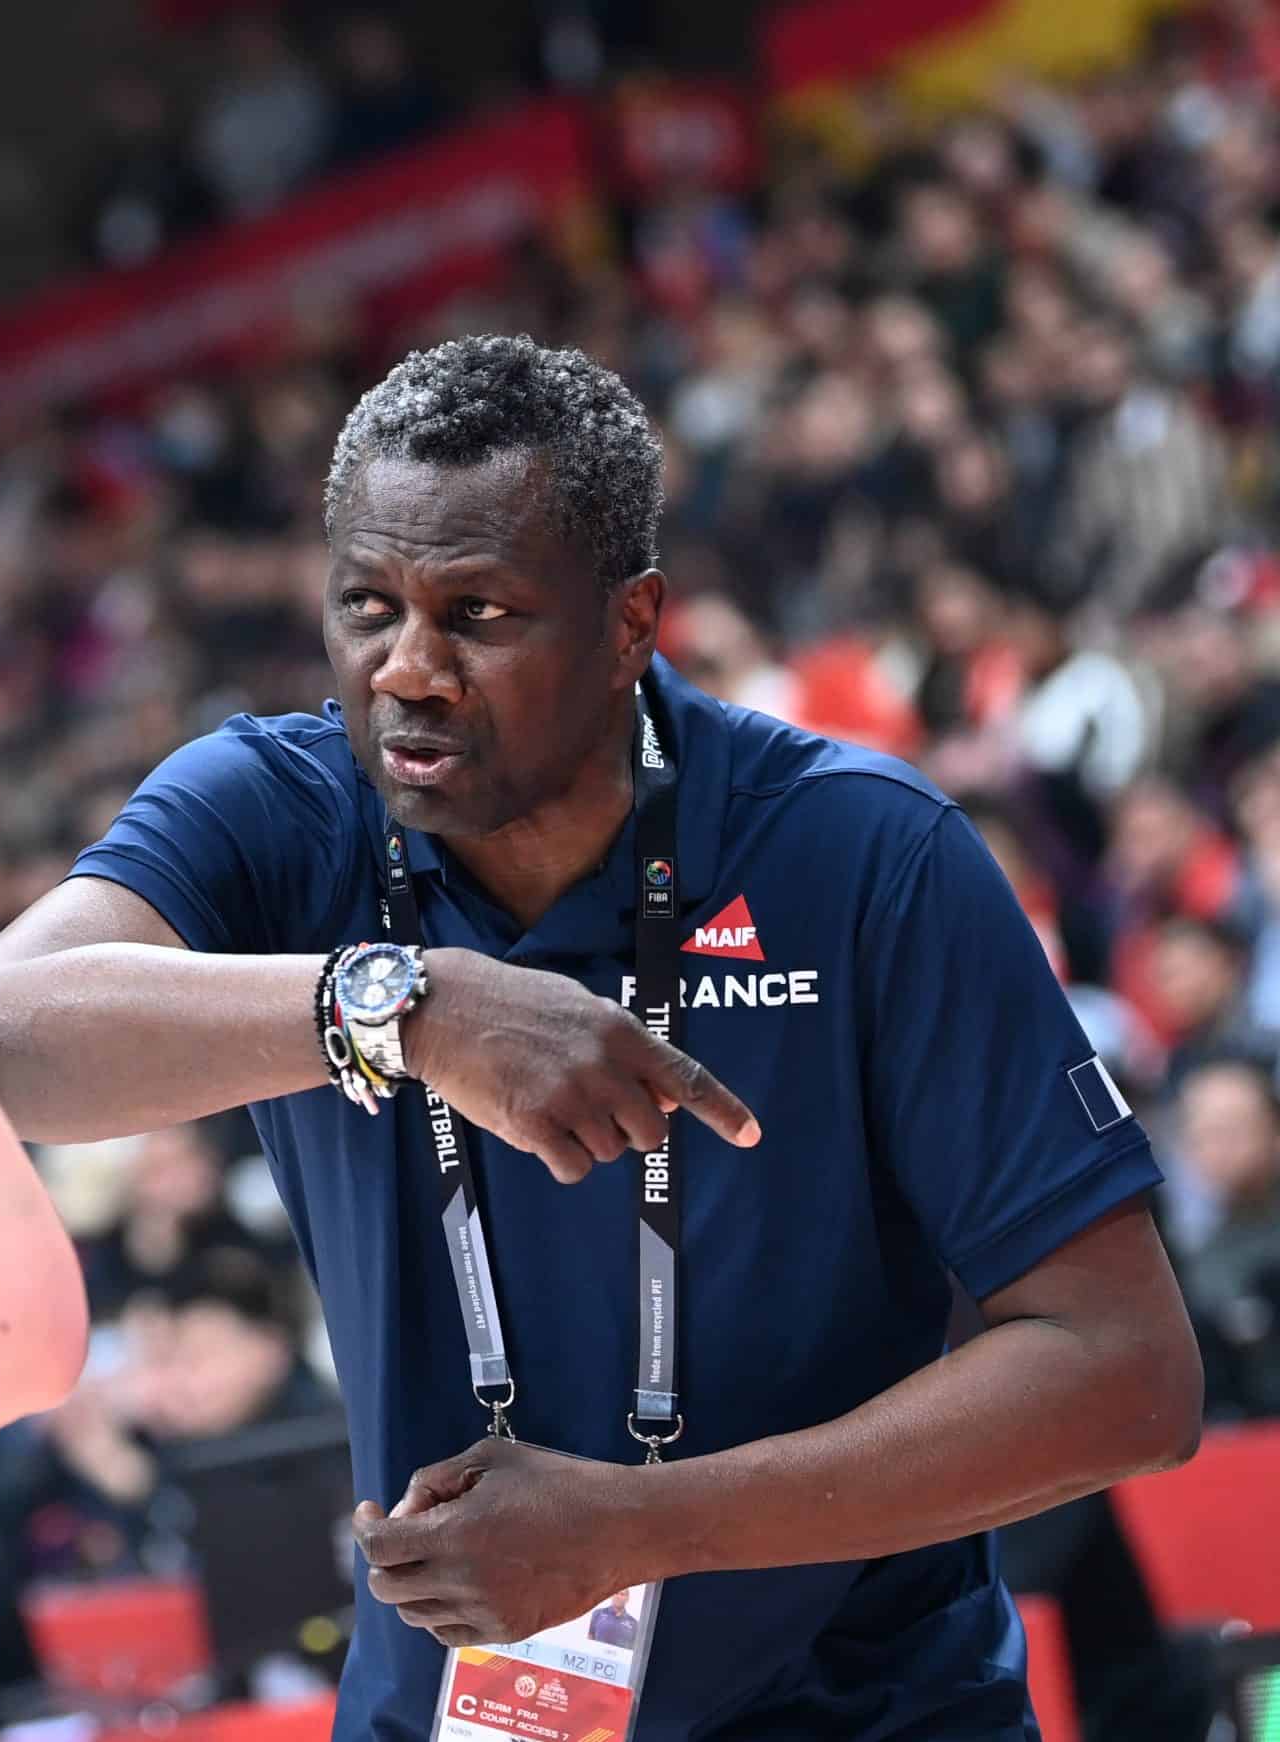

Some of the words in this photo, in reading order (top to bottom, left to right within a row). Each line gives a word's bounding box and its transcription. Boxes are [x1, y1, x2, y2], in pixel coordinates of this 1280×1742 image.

[648, 892, 669, 903] FIBA
[695, 926, 756, 948] MAIF
[621, 970, 819, 1008] FANCE
[425, 1087, 460, 1174] ETBALL
[651, 1279, 662, 1294] PET
[651, 1296, 664, 1333] recycled
[651, 1335, 662, 1357] from
[650, 1359, 661, 1383] Made
[563, 1653, 586, 1670] MZ
[594, 1662, 616, 1677] PC
[456, 1694, 477, 1716] C
[482, 1699, 512, 1714] TEAM
[517, 1707, 539, 1721] FRA
[480, 1711, 514, 1728] COURT
[516, 1720, 559, 1738] ACCESS
